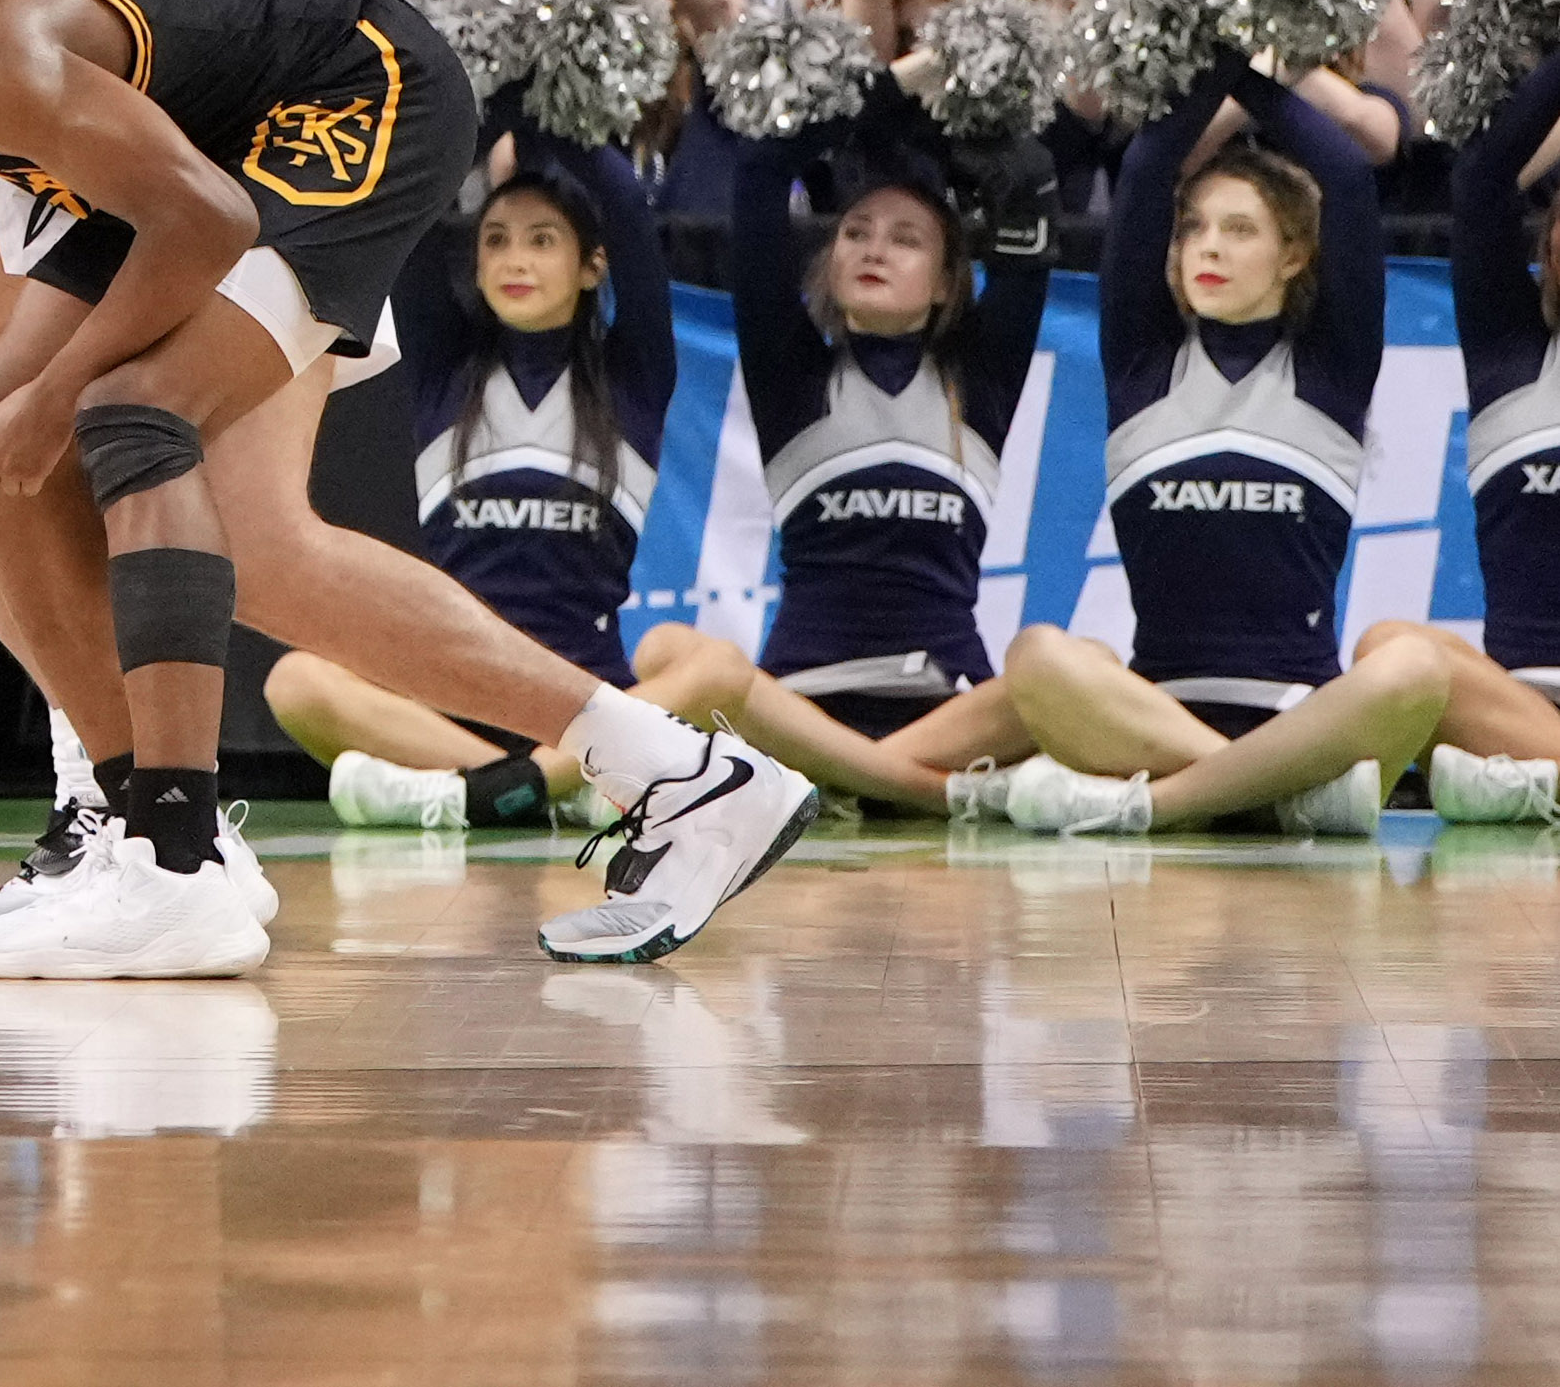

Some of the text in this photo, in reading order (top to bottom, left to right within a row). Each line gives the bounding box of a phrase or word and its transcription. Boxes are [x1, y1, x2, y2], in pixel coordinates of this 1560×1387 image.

[819, 488, 964, 524] XAVIER
[1149, 480, 1304, 513] XAVIER
[454, 498, 598, 531] XAVIER
